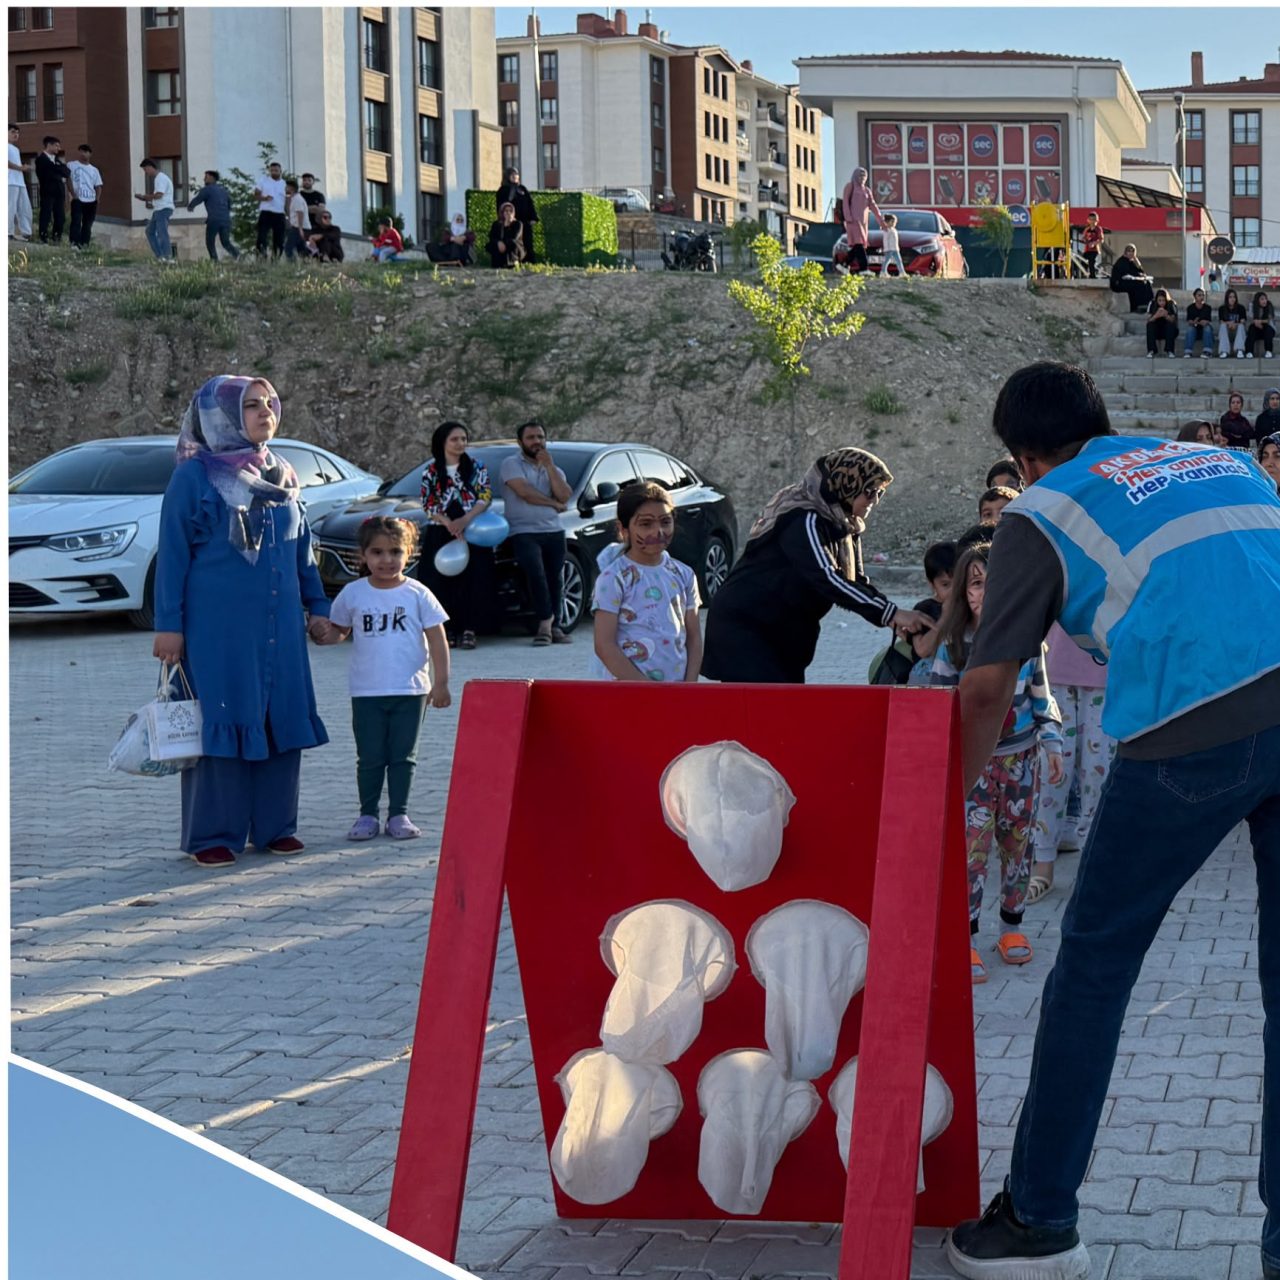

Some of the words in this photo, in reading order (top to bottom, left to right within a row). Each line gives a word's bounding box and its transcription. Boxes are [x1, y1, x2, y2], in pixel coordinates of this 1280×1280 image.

[974, 139, 992, 149] sec
[1035, 139, 1053, 149] sec
[1209, 245, 1231, 254] sec
[363, 613, 407, 632] BJK
